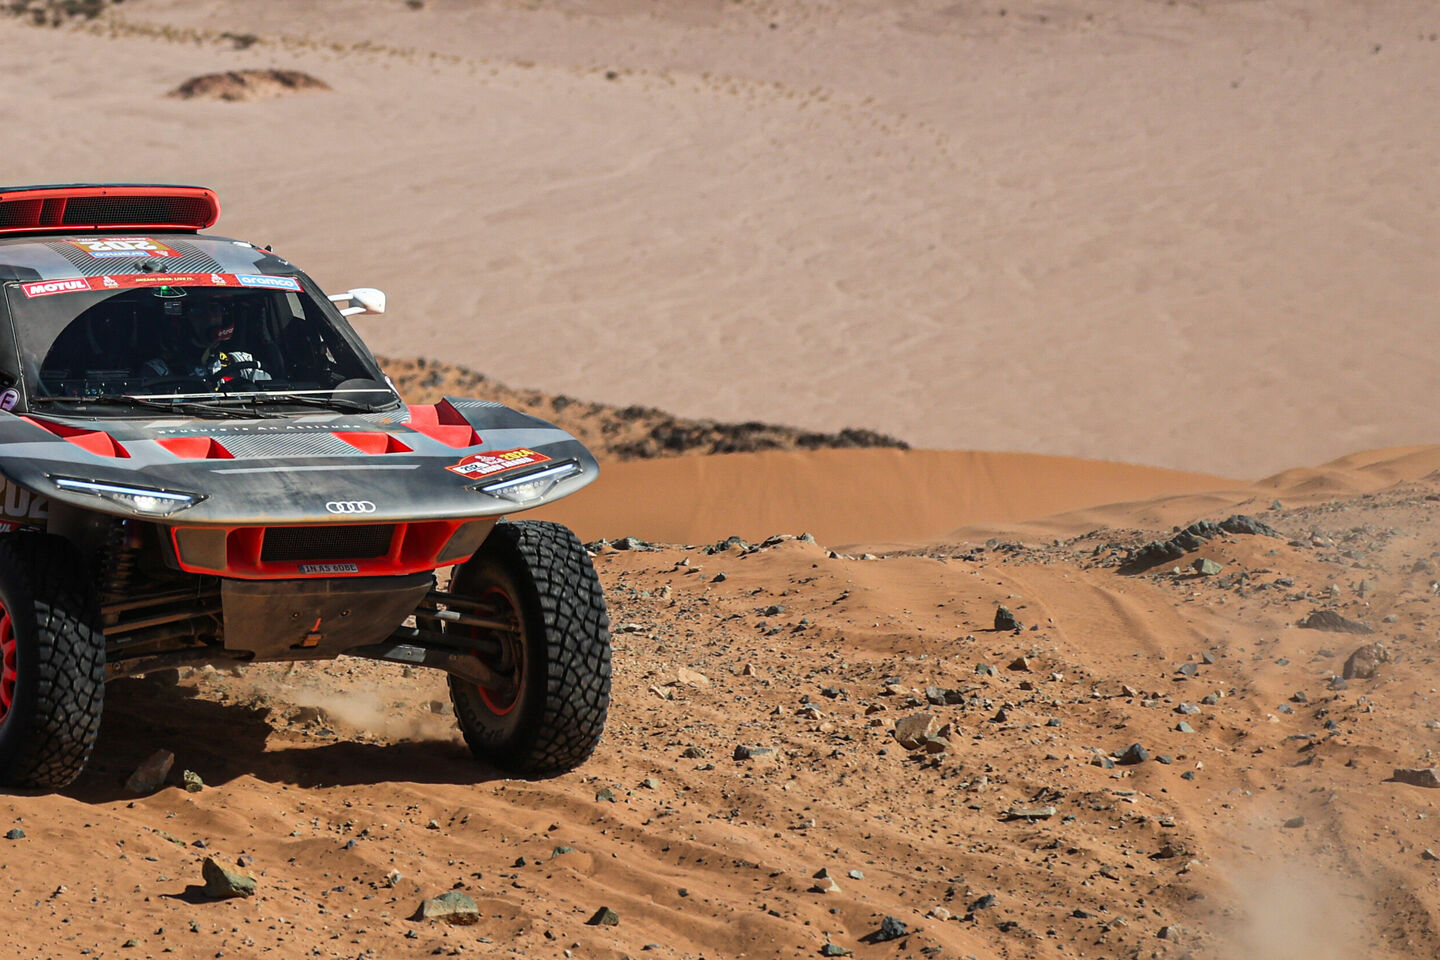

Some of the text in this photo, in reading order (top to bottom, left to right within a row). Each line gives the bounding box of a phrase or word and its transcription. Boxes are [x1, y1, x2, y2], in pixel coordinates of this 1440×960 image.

[80, 240, 157, 251] 202
[30, 280, 86, 295] MOTUL
[244, 276, 294, 287] aramco
[1, 393, 15, 408] E
[499, 449, 535, 461] 2024
